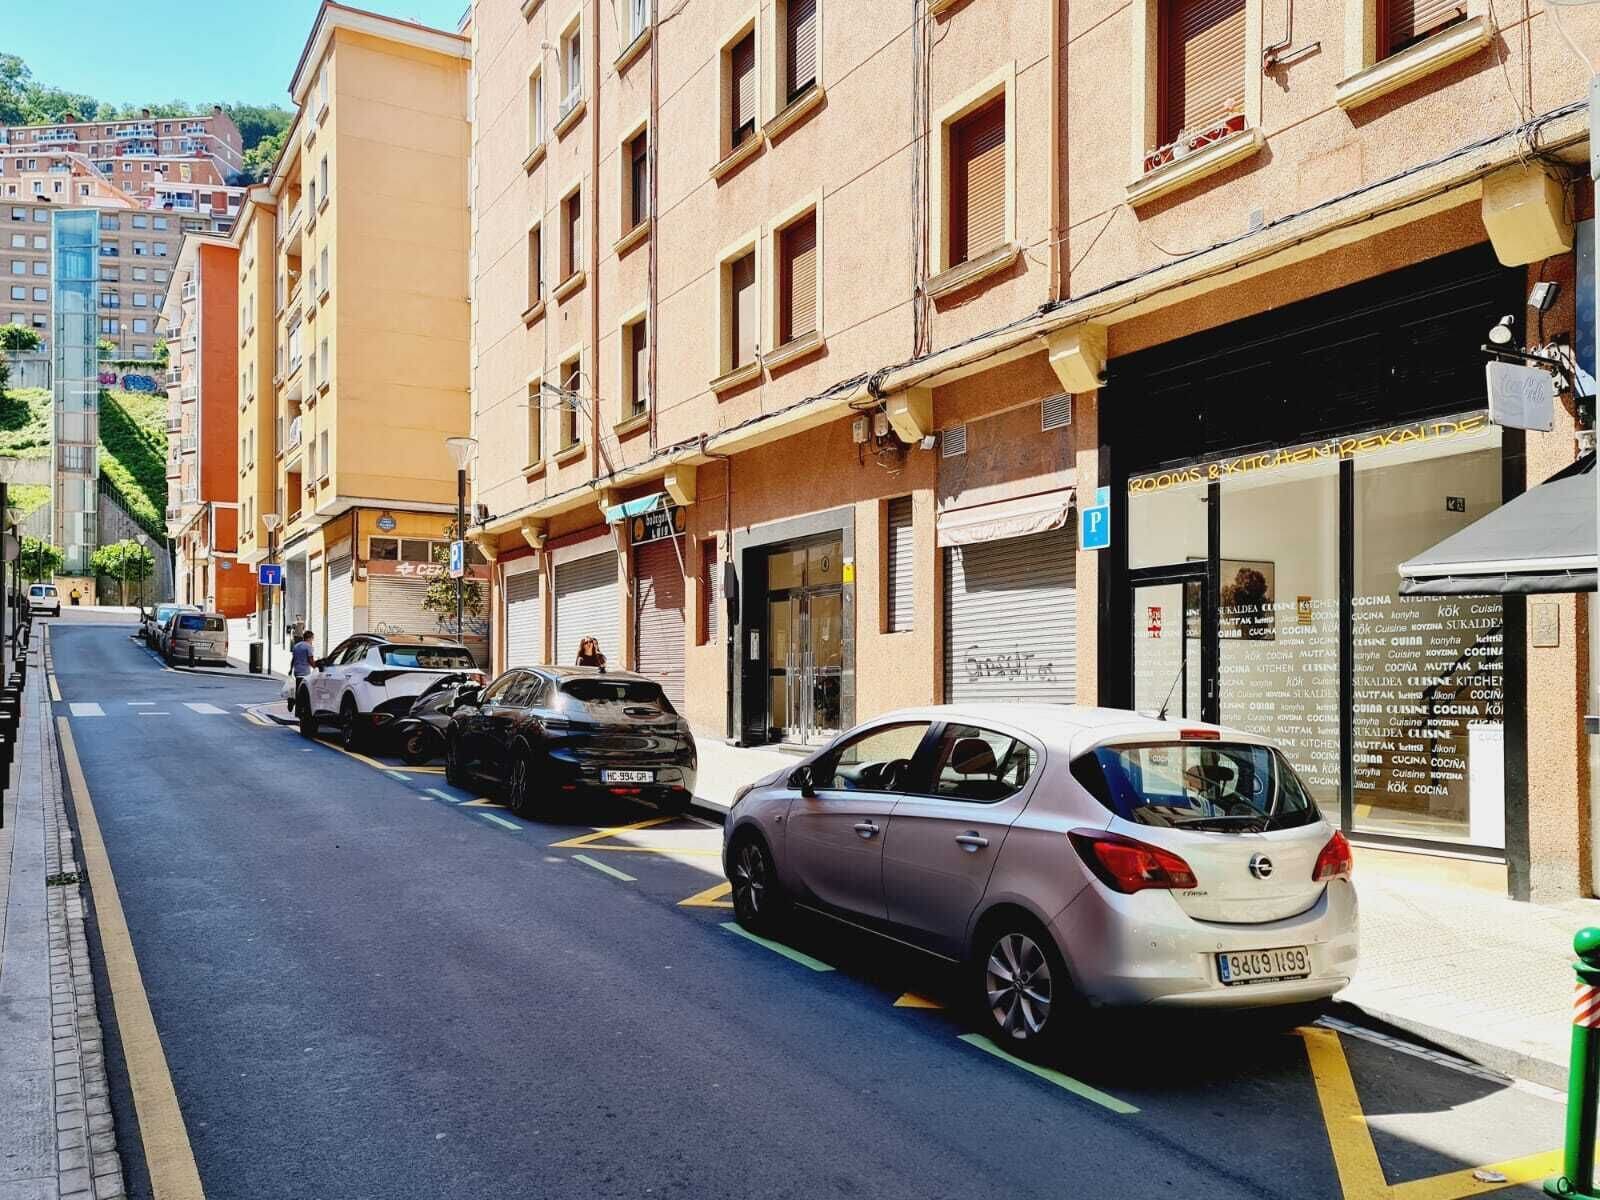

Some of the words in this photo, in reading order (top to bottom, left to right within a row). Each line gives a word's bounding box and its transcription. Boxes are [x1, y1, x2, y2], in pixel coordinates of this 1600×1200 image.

[1130, 468, 1202, 496] ROOMS
[1208, 464, 1220, 479] &
[1225, 444, 1337, 476] KITCHEN
[1090, 511, 1102, 533] P
[1352, 595, 1391, 607] COCINA
[1438, 604, 1460, 617] kök
[1375, 624, 1408, 633] Cuisine
[1431, 636, 1461, 647] konyha
[1433, 704, 1479, 715] COCINA
[1389, 717, 1423, 726] Cuisine
[1432, 744, 1457, 754] Jikoni
[1392, 755, 1427, 765] CUCINA
[1392, 769, 1426, 779] Cuisine
[1387, 781, 1408, 793] kök
